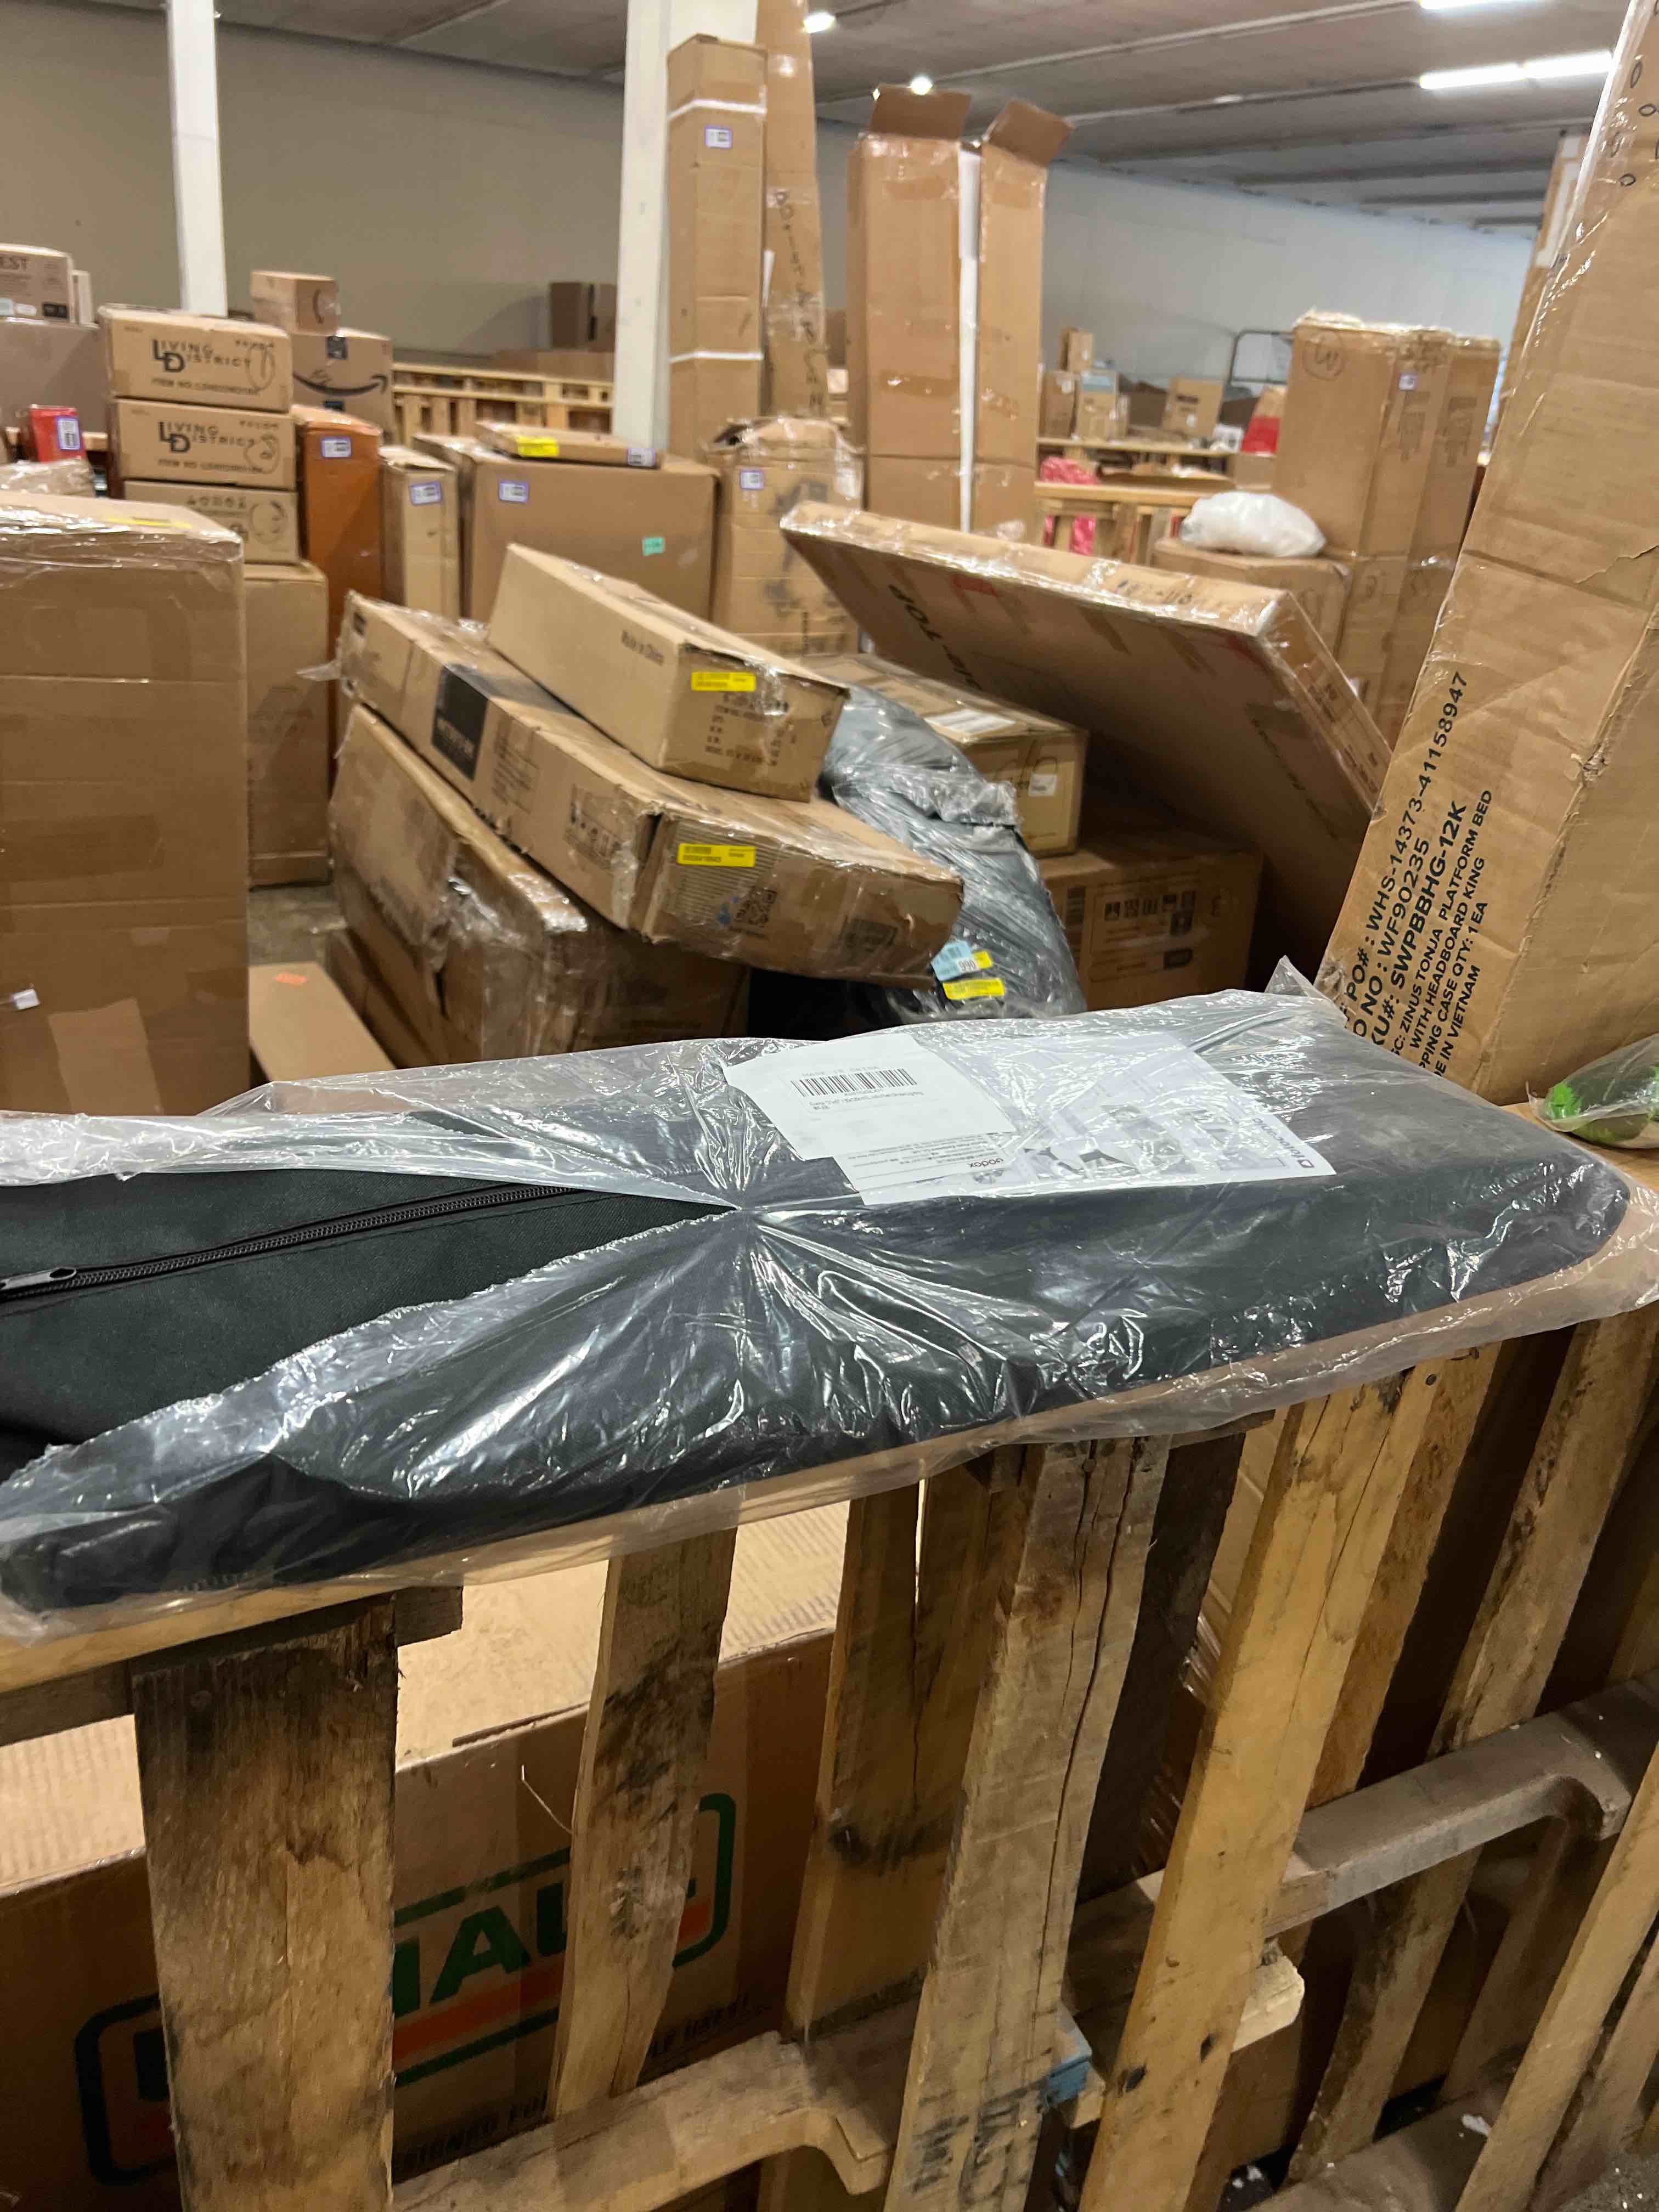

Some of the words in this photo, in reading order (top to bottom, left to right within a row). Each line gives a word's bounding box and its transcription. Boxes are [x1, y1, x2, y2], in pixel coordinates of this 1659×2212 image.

[1345, 947, 1369, 1001] PO#
[1365, 671, 1468, 931] WHS-14373-41158947
[1371, 994, 1400, 1046] KU#:
[1391, 800, 1467, 990] SWPBBHG-12K
[1376, 837, 1429, 956] WF90235
[1400, 983, 1422, 1034] ZINUS
[1415, 929, 1443, 980] TONJA
[1438, 828, 1479, 921] PLATFORM
[1471, 790, 1492, 827] BED
[1468, 926, 1479, 934] 1
[1470, 902, 1488, 924] EA
[1409, 1007, 1433, 1048] WITH
[1425, 902, 1469, 1007] HEADBOARD
[1462, 856, 1486, 900] KING
[1437, 978, 1458, 1022] CASE
[1452, 938, 1474, 977] QTY:
[1440, 1040, 1454, 1061] IN
[1447, 964, 1481, 1038] VIETNAM
